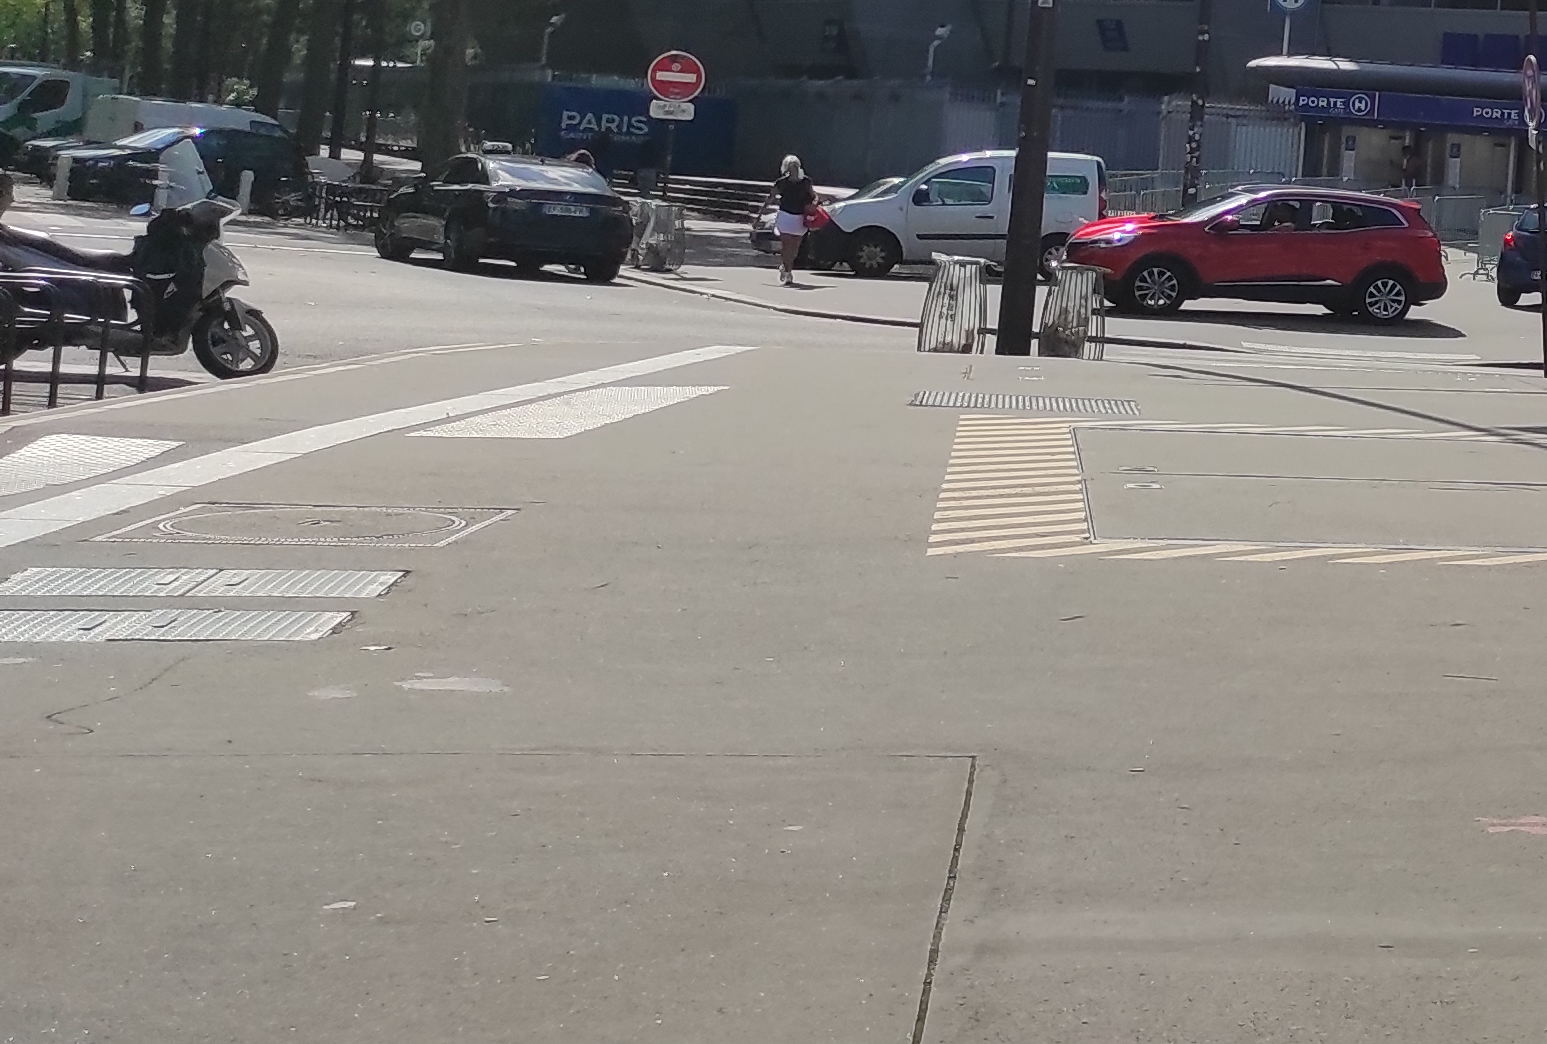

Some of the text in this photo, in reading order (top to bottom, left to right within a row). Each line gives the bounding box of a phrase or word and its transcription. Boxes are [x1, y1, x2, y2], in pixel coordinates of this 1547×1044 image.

[1298, 95, 1347, 109] PORTE
[1473, 107, 1520, 120] PORTE
[560, 109, 649, 135] PARIS
